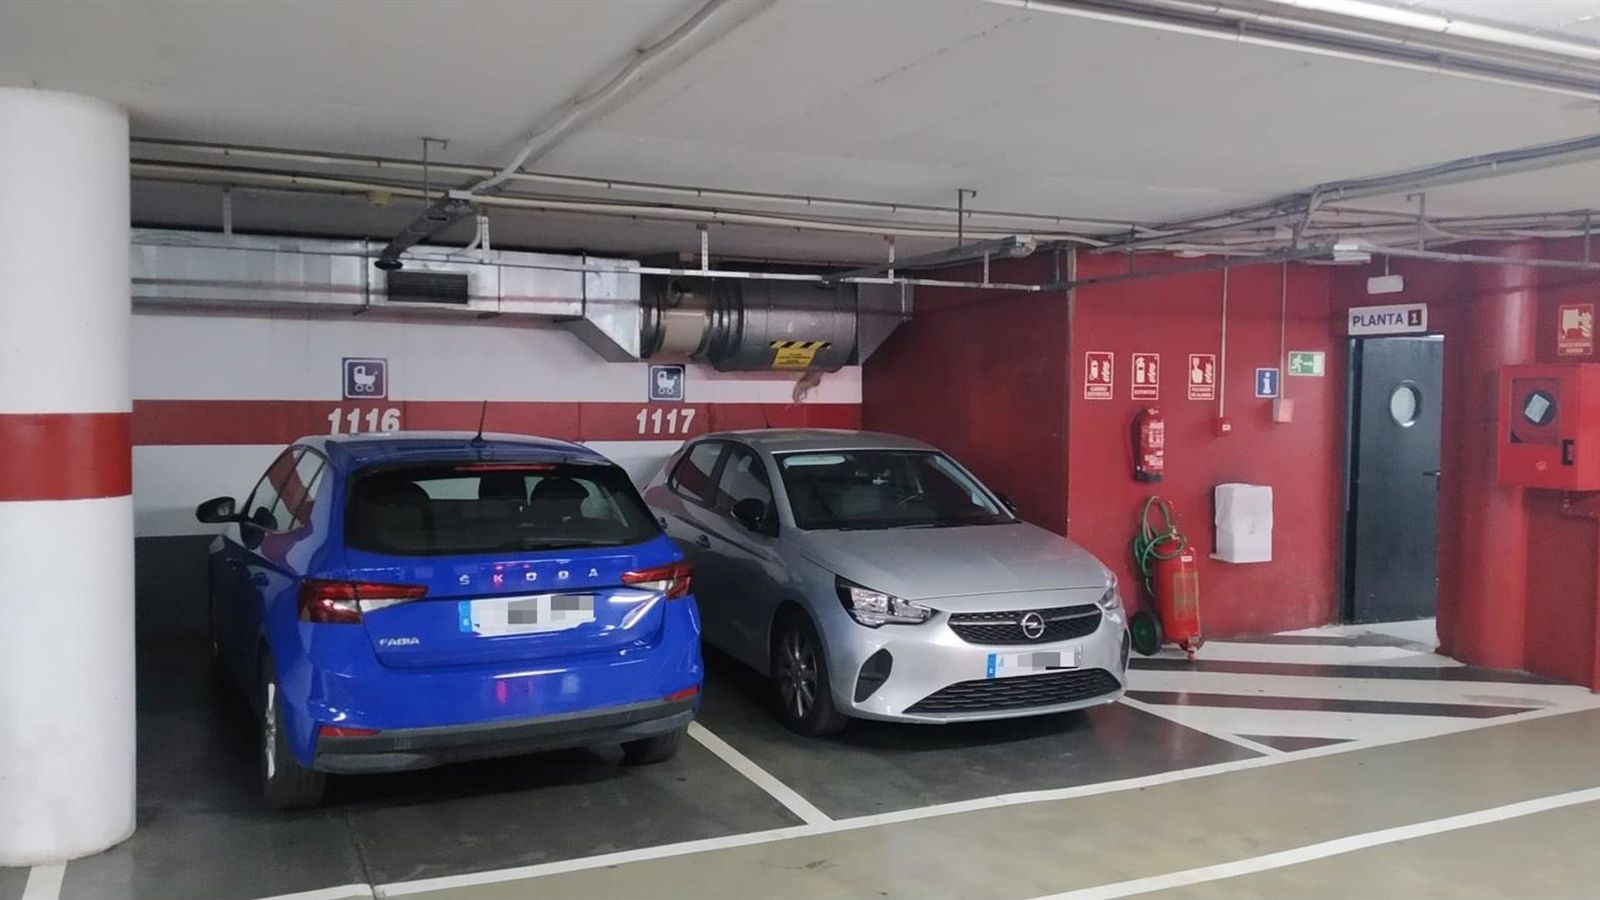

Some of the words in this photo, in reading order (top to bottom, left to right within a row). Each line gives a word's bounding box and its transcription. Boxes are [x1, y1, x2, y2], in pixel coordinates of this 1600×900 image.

[1352, 313, 1404, 327] PLANTA
[327, 407, 400, 435] 1116
[636, 408, 696, 433] 1117
[379, 637, 420, 646] FABIA
